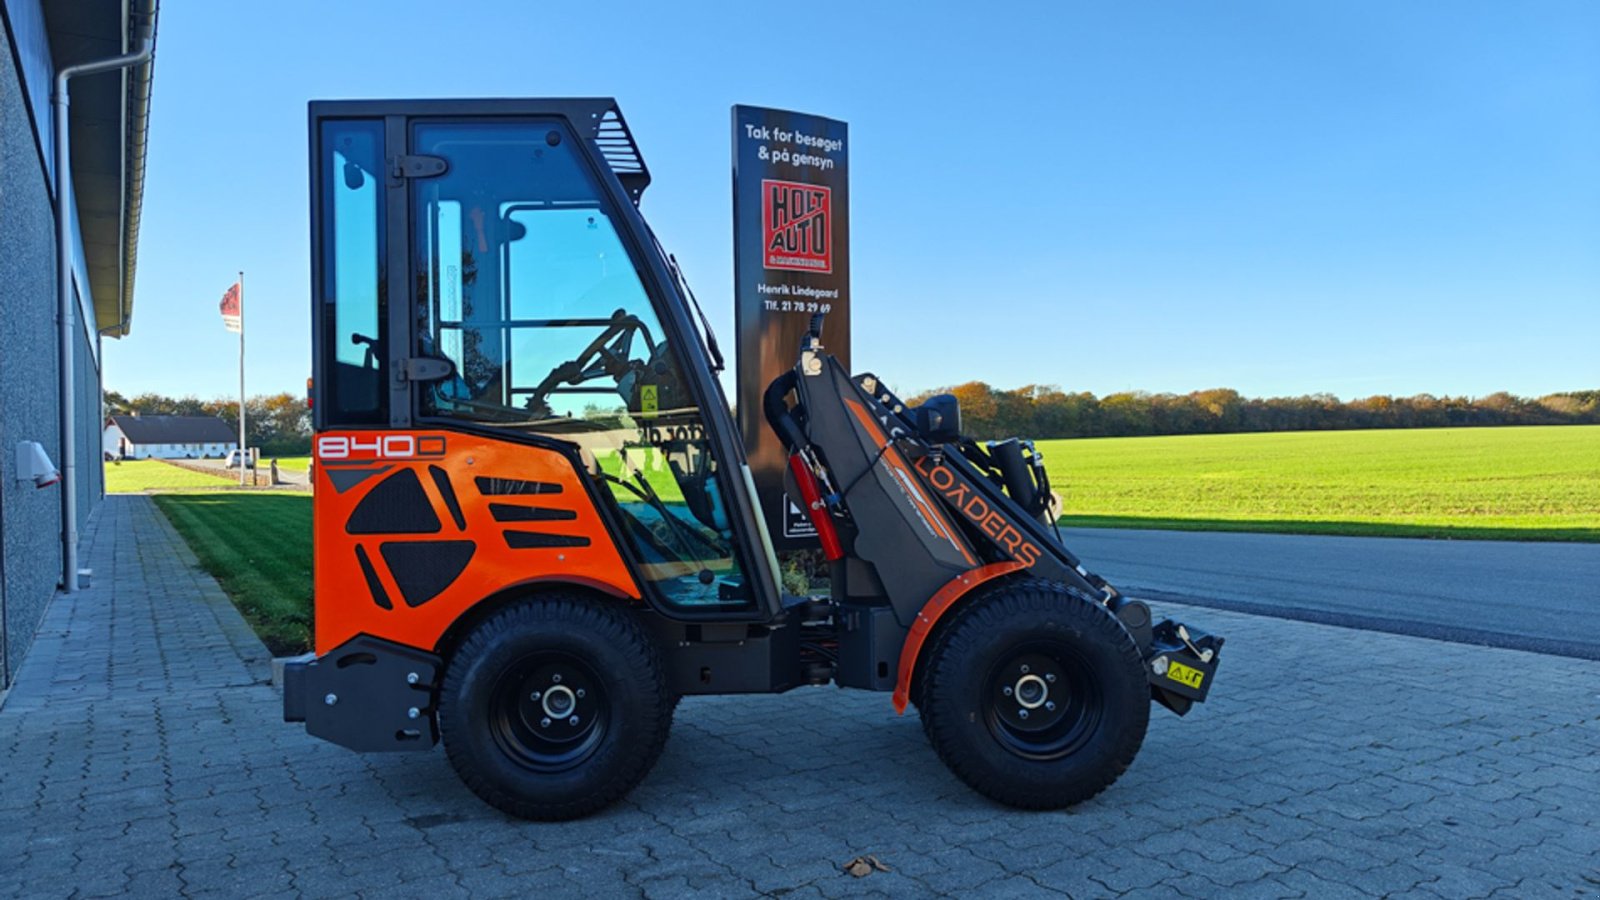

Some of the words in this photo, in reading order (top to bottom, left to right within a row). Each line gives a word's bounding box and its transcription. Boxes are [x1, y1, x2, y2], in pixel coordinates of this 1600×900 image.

[745, 124, 770, 139] Tak
[773, 127, 792, 142] for
[795, 130, 842, 152] besøget
[758, 145, 769, 160] &
[772, 148, 789, 164] på
[792, 152, 833, 170] gensyn
[772, 185, 825, 230] HOLT
[769, 210, 825, 254] AUTO
[757, 283, 790, 295] Henrik
[791, 285, 838, 299] Lindegaard
[781, 301, 791, 311] 21
[794, 301, 805, 312] 78
[807, 302, 818, 313] 29
